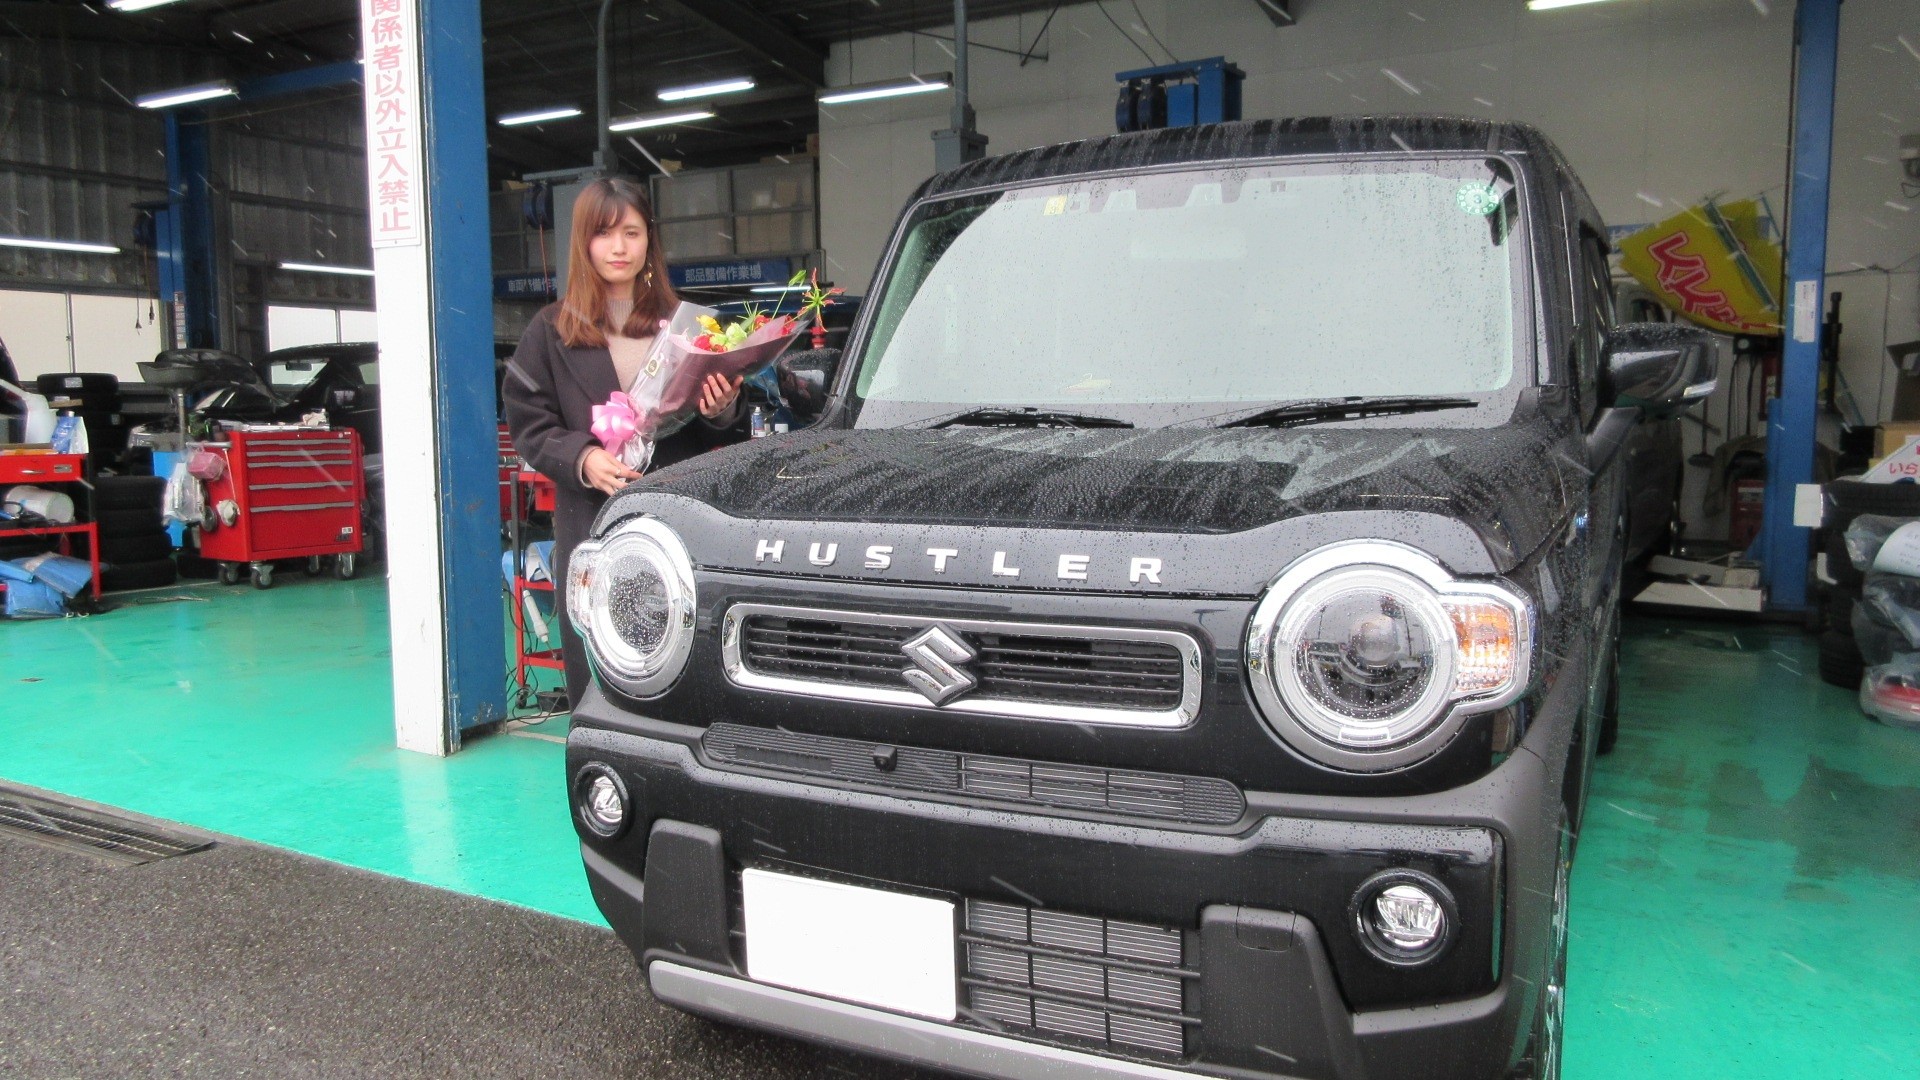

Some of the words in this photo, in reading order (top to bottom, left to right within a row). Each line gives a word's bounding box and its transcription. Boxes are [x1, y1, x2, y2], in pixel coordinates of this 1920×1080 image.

[685, 263, 762, 283] 部品整備作業場
[755, 539, 1163, 585] HUSTLER
